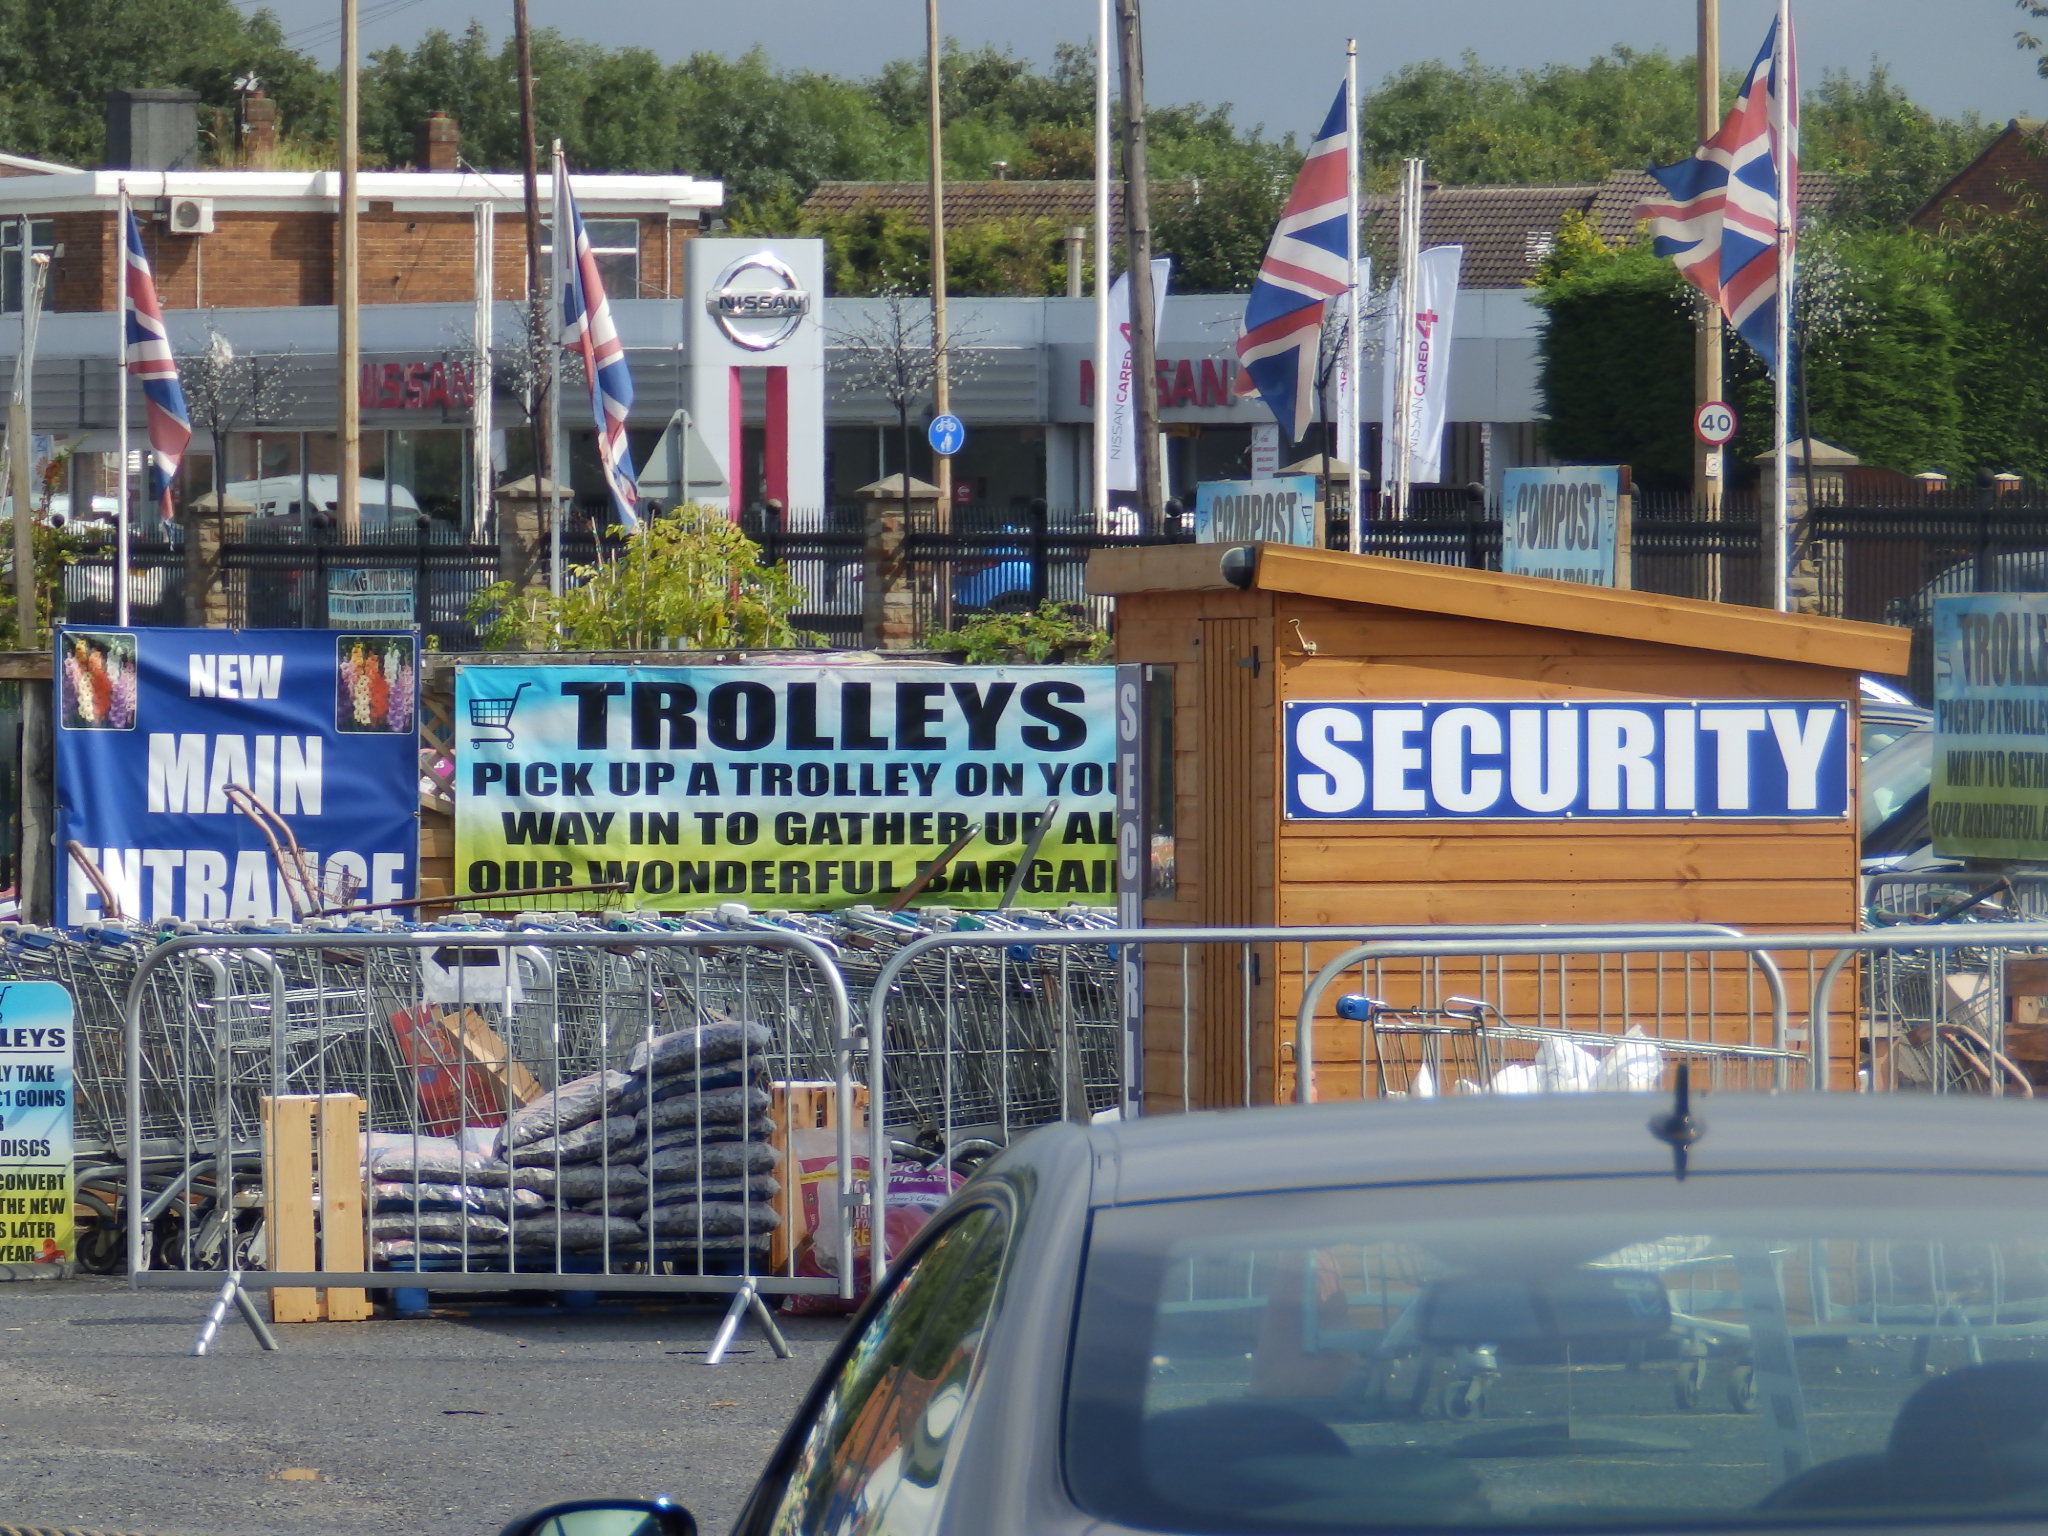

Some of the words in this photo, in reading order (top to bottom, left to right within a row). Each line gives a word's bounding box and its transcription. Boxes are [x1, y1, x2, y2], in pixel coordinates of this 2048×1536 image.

[719, 295, 801, 310] NISSAN
[1079, 359, 1229, 407] NSAN
[1701, 414, 1731, 432] 40
[1212, 492, 1297, 544] COMPOST
[1516, 482, 1602, 550] COMPOST
[188, 654, 283, 699] NEW
[561, 681, 1088, 752] TROLLEYS
[1939, 699, 1970, 735] PICK
[148, 734, 323, 815] MAIN
[1296, 707, 1836, 812] SECURITY
[472, 762, 595, 797] PICK
[608, 762, 676, 797] UP
[685, 762, 720, 796] A
[728, 762, 942, 797] TROLLEY
[955, 762, 1024, 797] ON
[501, 811, 616, 846] WAY
[629, 811, 680, 846] IN
[693, 811, 759, 846] TO
[774, 811, 972, 846] GATHER
[985, 811, 1050, 846] UP
[67, 847, 405, 926] ENTRANCE
[468, 860, 573, 894] OUR
[587, 860, 900, 894] WONDERFUL
[16, 1065, 55, 1082] TAKE
[15, 1089, 65, 1107] COINS
[1, 1139, 50, 1157] DISCS
[30, 1198, 65, 1214] NEW
[11, 1222, 55, 1238] LATER
